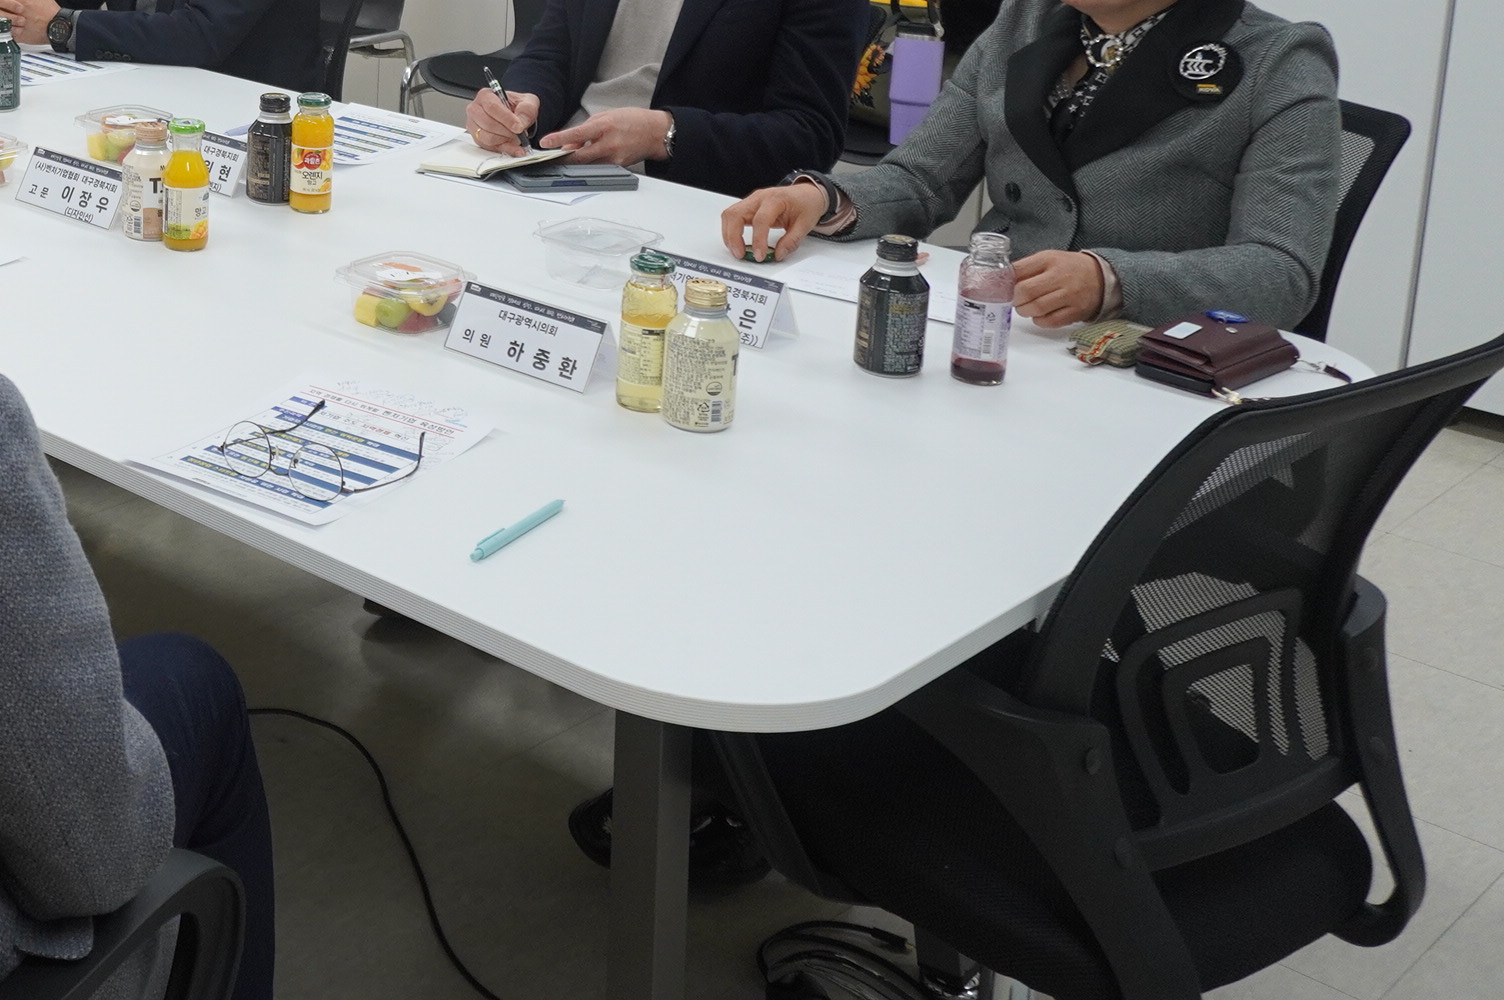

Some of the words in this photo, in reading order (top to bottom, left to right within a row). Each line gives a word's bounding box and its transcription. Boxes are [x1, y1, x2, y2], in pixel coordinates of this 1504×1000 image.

[204, 145, 239, 162] 대구경북지회
[35, 161, 80, 181] (사)벤처기업협회
[82, 175, 118, 193] 대구경북지회
[498, 309, 559, 337] 대구광역시의회
